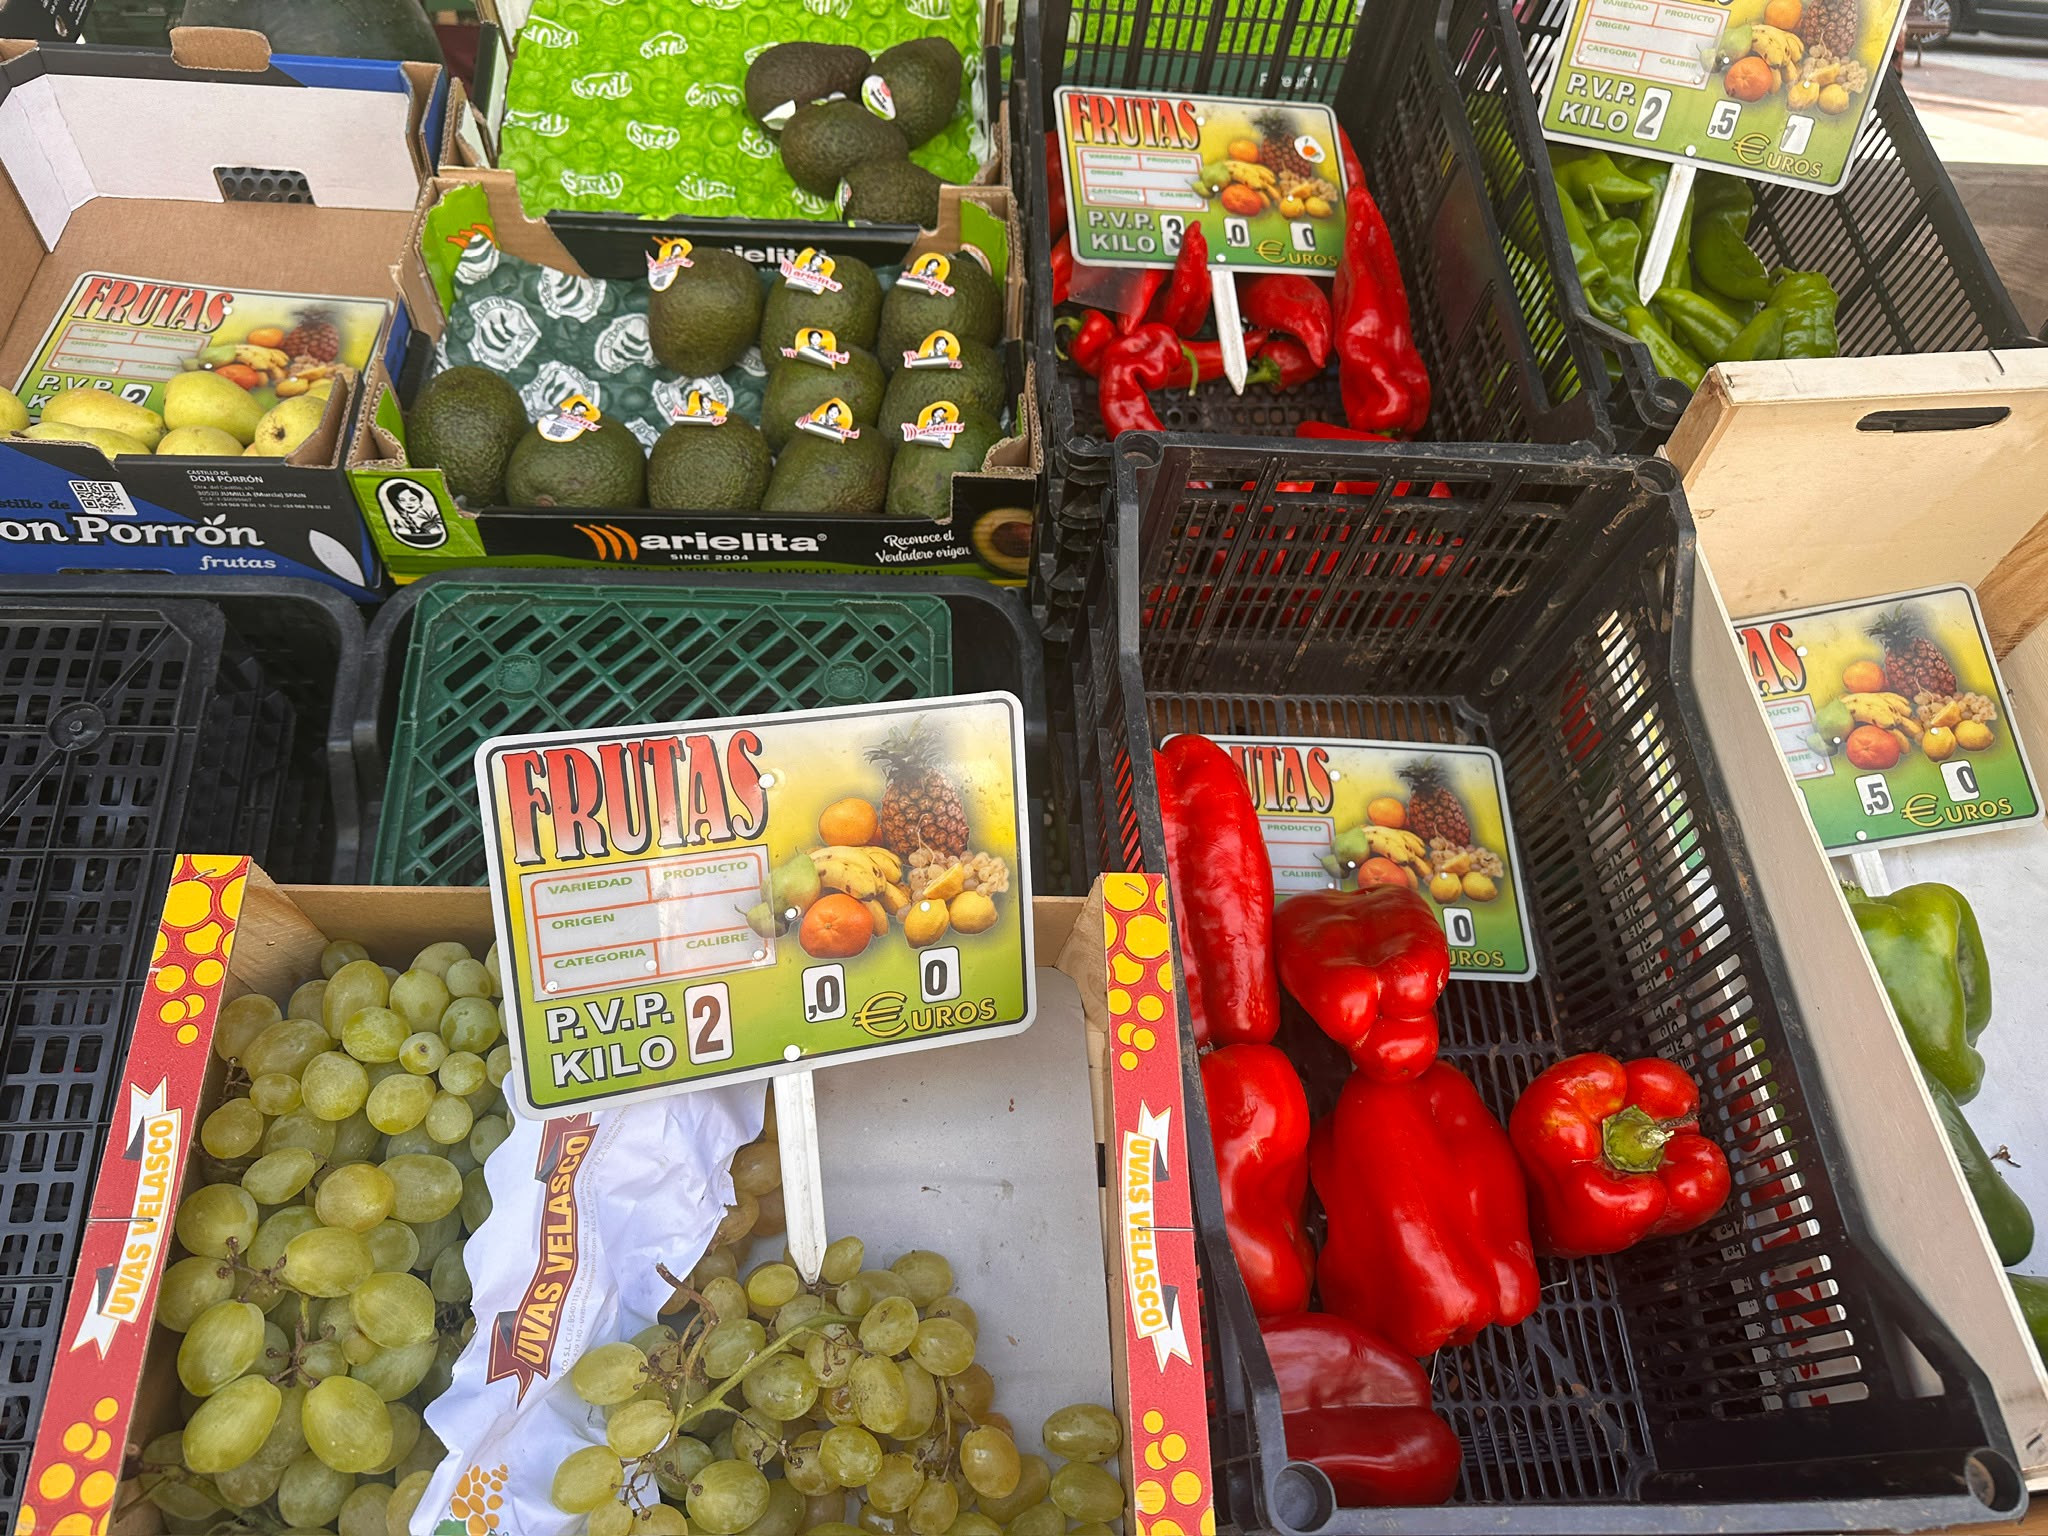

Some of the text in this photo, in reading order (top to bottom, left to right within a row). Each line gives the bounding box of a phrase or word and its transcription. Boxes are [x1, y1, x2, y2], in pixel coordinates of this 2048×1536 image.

[1595, 19, 1631, 31] ORIGEN
[1664, 8, 1716, 24] PRODUCTO
[1586, 44, 1638, 58] CATEGORIA
[1566, 73, 1636, 105] P.V.P.
[1067, 94, 1200, 150] FRUTAS
[1558, 101, 1629, 133] KILO
[1635, 96, 1661, 137] 2
[1709, 108, 1737, 135] ,5
[1088, 154, 1192, 165] VARIEDAD PRODUCTO
[1091, 169, 1124, 177] ORIGEN
[1091, 188, 1193, 199] CATEGORIA CALIBRE
[1089, 211, 1155, 231] P.V.P.
[1091, 233, 1157, 253] KILO
[1166, 218, 1182, 249] 3
[72, 277, 234, 333] FRUTAS
[71, 340, 108, 348] ORIGEN
[217, 474, 264, 483] PORRÓN
[48, 500, 70, 510] de
[884, 529, 955, 550] Reconoce el
[200, 556, 277, 571] frutas
[670, 553, 710, 561] SINCE
[875, 545, 971, 564] Verdadero origen
[502, 729, 769, 864] FRUTAS
[1867, 766, 1977, 815] ,5 0
[1266, 823, 1322, 833] PRODUCTO
[547, 860, 749, 896] VARIEDAD PRODUCTO
[1281, 870, 1323, 878] CALIBRE
[551, 912, 616, 931] ORIGEN
[1453, 914, 1473, 943] 0
[553, 931, 750, 970] CATEGORIA CALIBRE
[546, 992, 674, 1043] P.V.P.
[692, 959, 948, 1056] 2 ,0 0
[552, 1036, 677, 1088] KILO
[108, 1119, 174, 1315] UVAS VELASCO
[1128, 1139, 1163, 1327] UVAS VELASCO
[516, 1135, 590, 1364] UVAS VELASCO
